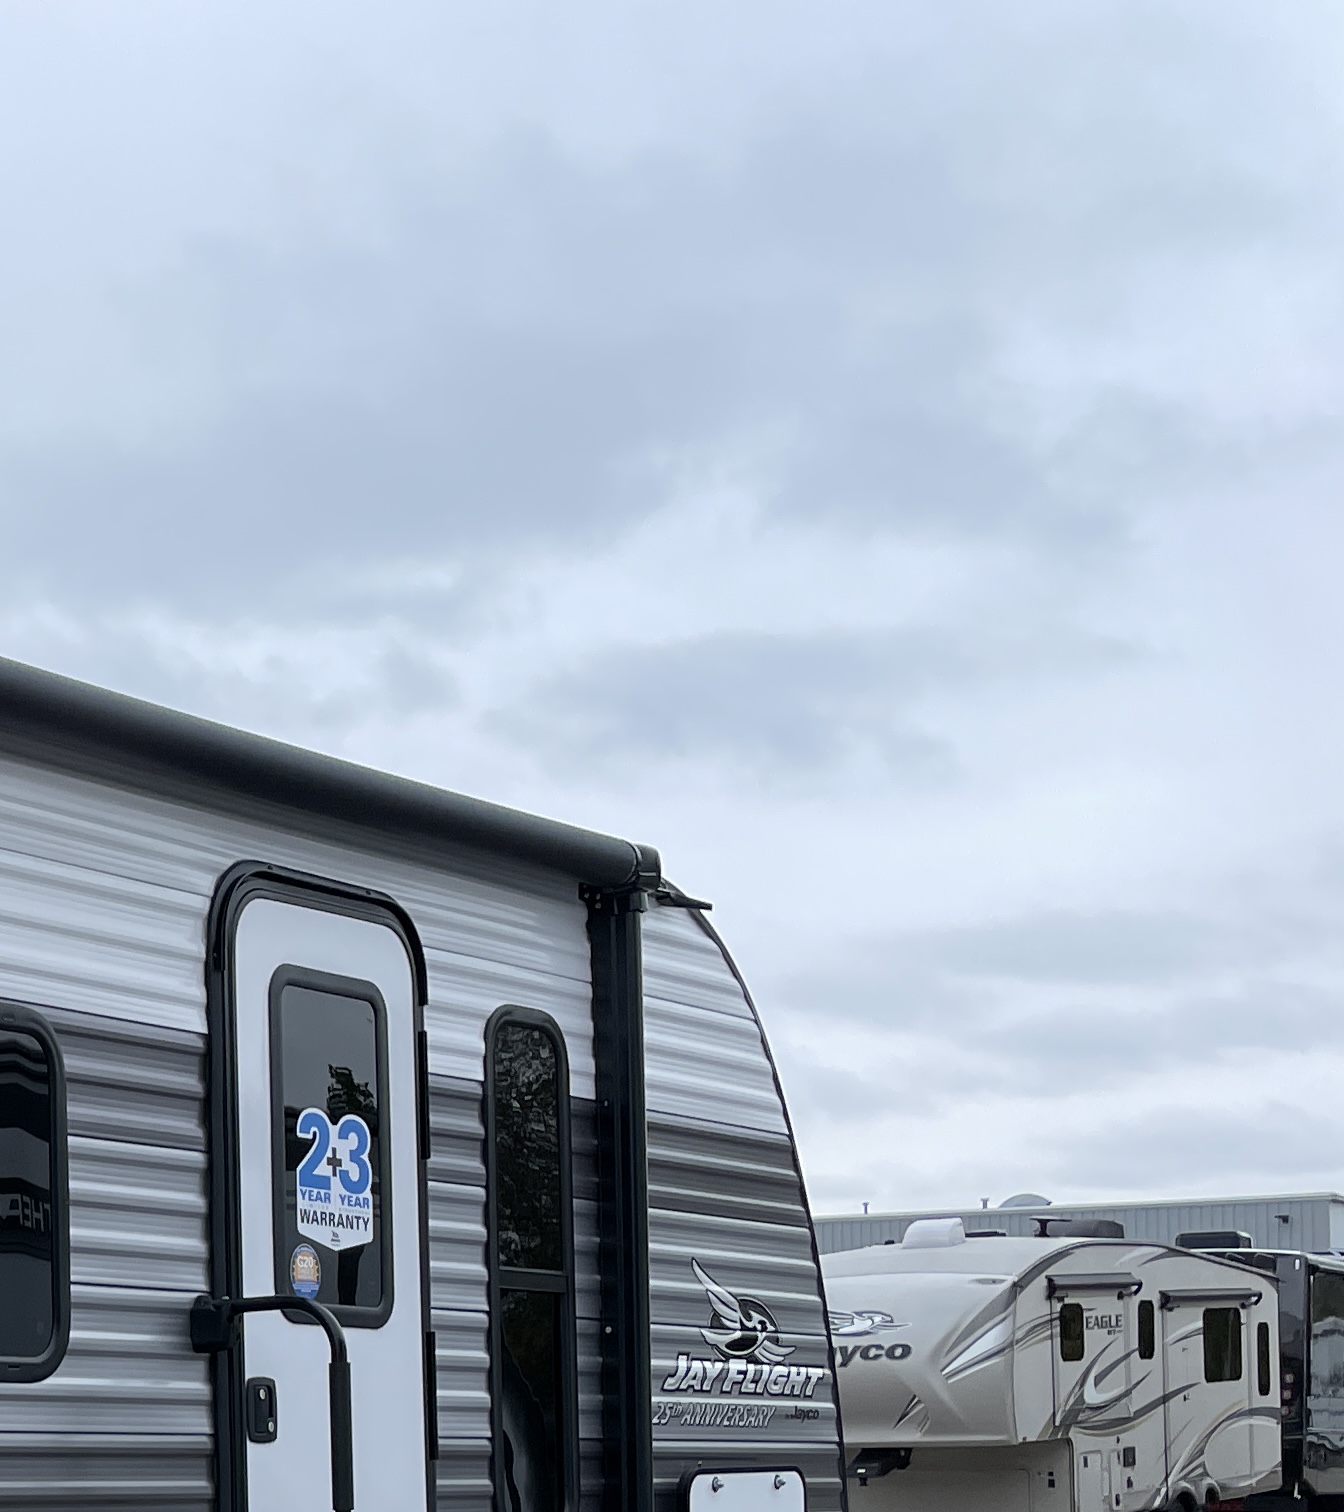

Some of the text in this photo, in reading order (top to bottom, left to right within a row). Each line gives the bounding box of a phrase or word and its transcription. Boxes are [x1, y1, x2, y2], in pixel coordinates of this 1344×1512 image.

[299, 1188, 370, 1210] YEAR YEAR
[299, 1208, 370, 1232] WARRANTY
[1085, 1314, 1123, 1330] EAGLE
[833, 1343, 912, 1368] yco
[661, 1352, 825, 1397] JAY FLIGHT
[652, 1402, 776, 1427] 25th ANNIVERSARY
[792, 1405, 820, 1423] Jayco
